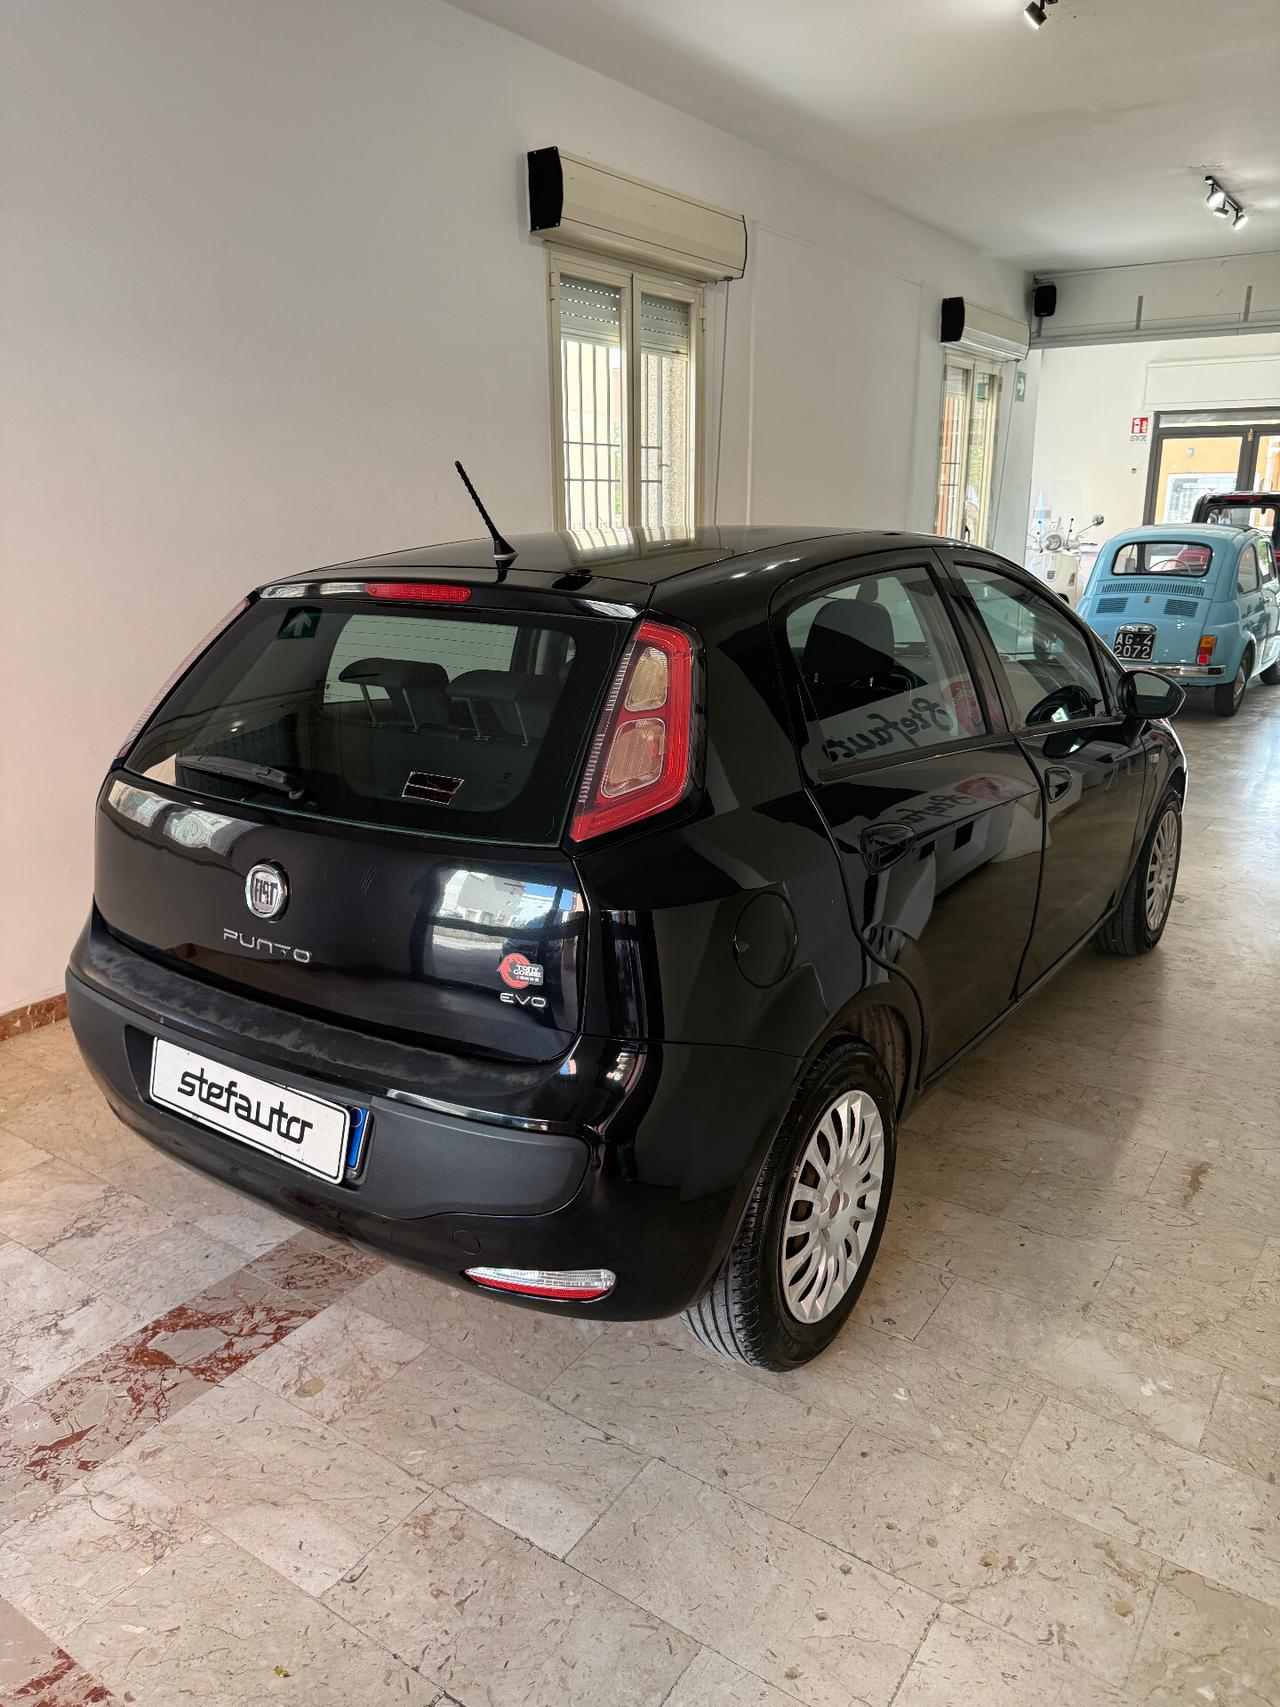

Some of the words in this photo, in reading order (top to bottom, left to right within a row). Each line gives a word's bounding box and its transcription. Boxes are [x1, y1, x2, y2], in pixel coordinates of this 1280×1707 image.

[1116, 633, 1134, 645] AG
[1143, 634, 1152, 646] 4
[1114, 645, 1151, 659] 2072
[255, 878, 278, 906] FIAT
[223, 928, 312, 963] PUNTO
[500, 993, 546, 1008] EVO
[177, 1067, 313, 1144] stefauto
